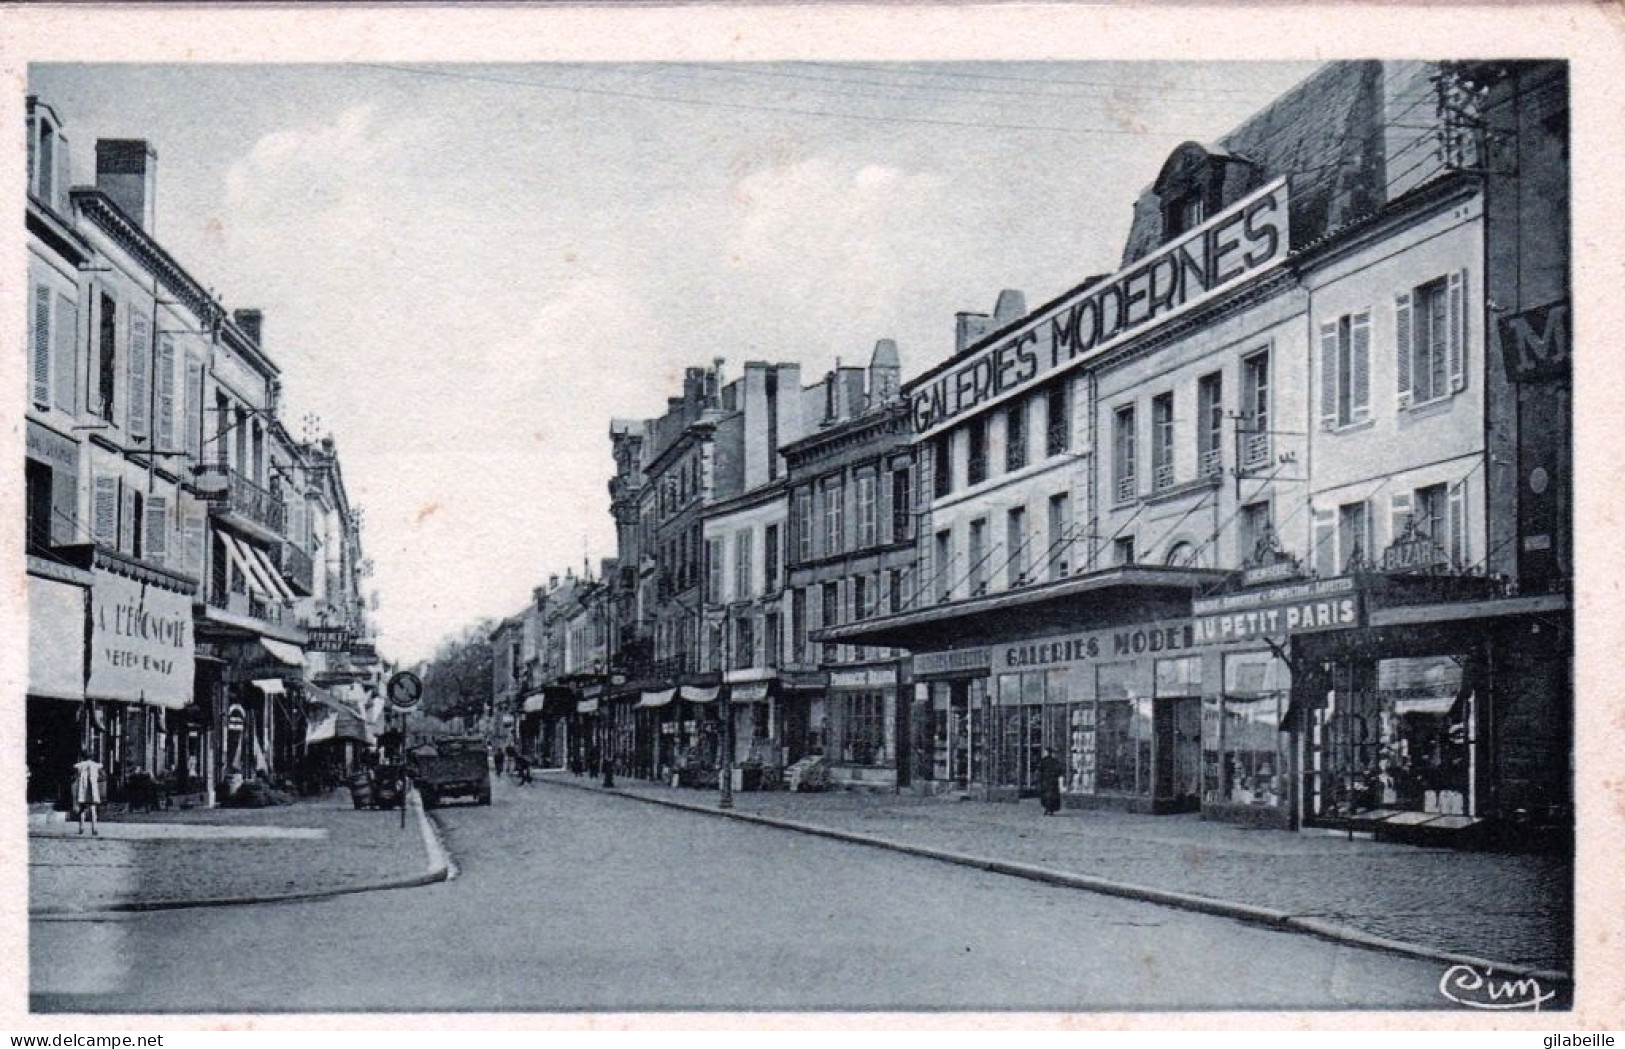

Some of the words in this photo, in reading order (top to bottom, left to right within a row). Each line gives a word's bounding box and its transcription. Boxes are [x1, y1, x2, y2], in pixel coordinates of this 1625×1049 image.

[912, 335, 1038, 434] GALERIES
[1051, 193, 1279, 368] MODERNES
[1386, 541, 1432, 570] BAZAR
[1194, 616, 1215, 640] AU
[1221, 610, 1279, 637] PETIT
[1286, 600, 1354, 629] PARIS
[1006, 637, 1100, 667] GALERIES
